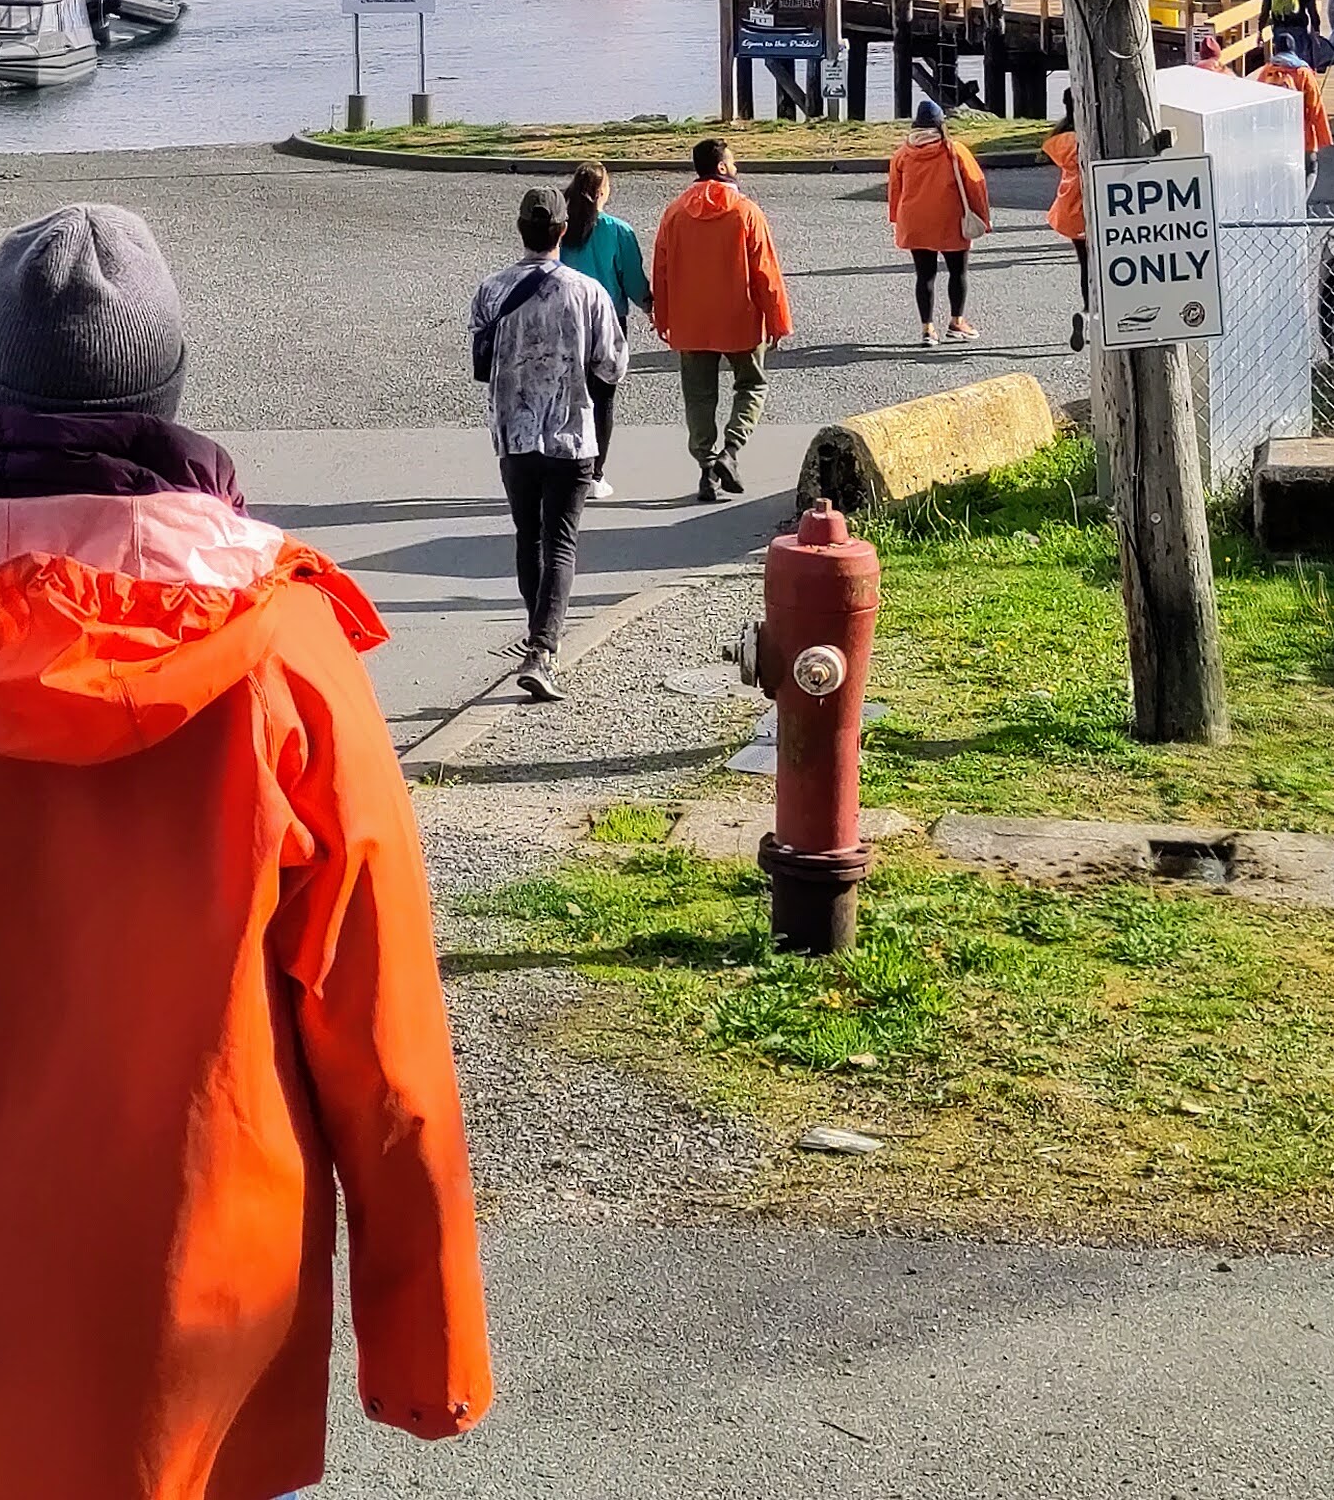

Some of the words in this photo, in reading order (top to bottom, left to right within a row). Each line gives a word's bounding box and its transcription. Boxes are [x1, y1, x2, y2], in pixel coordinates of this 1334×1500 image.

[1106, 176, 1201, 217] RPM
[1105, 220, 1208, 246] PARKING
[1108, 250, 1210, 287] ONLY
